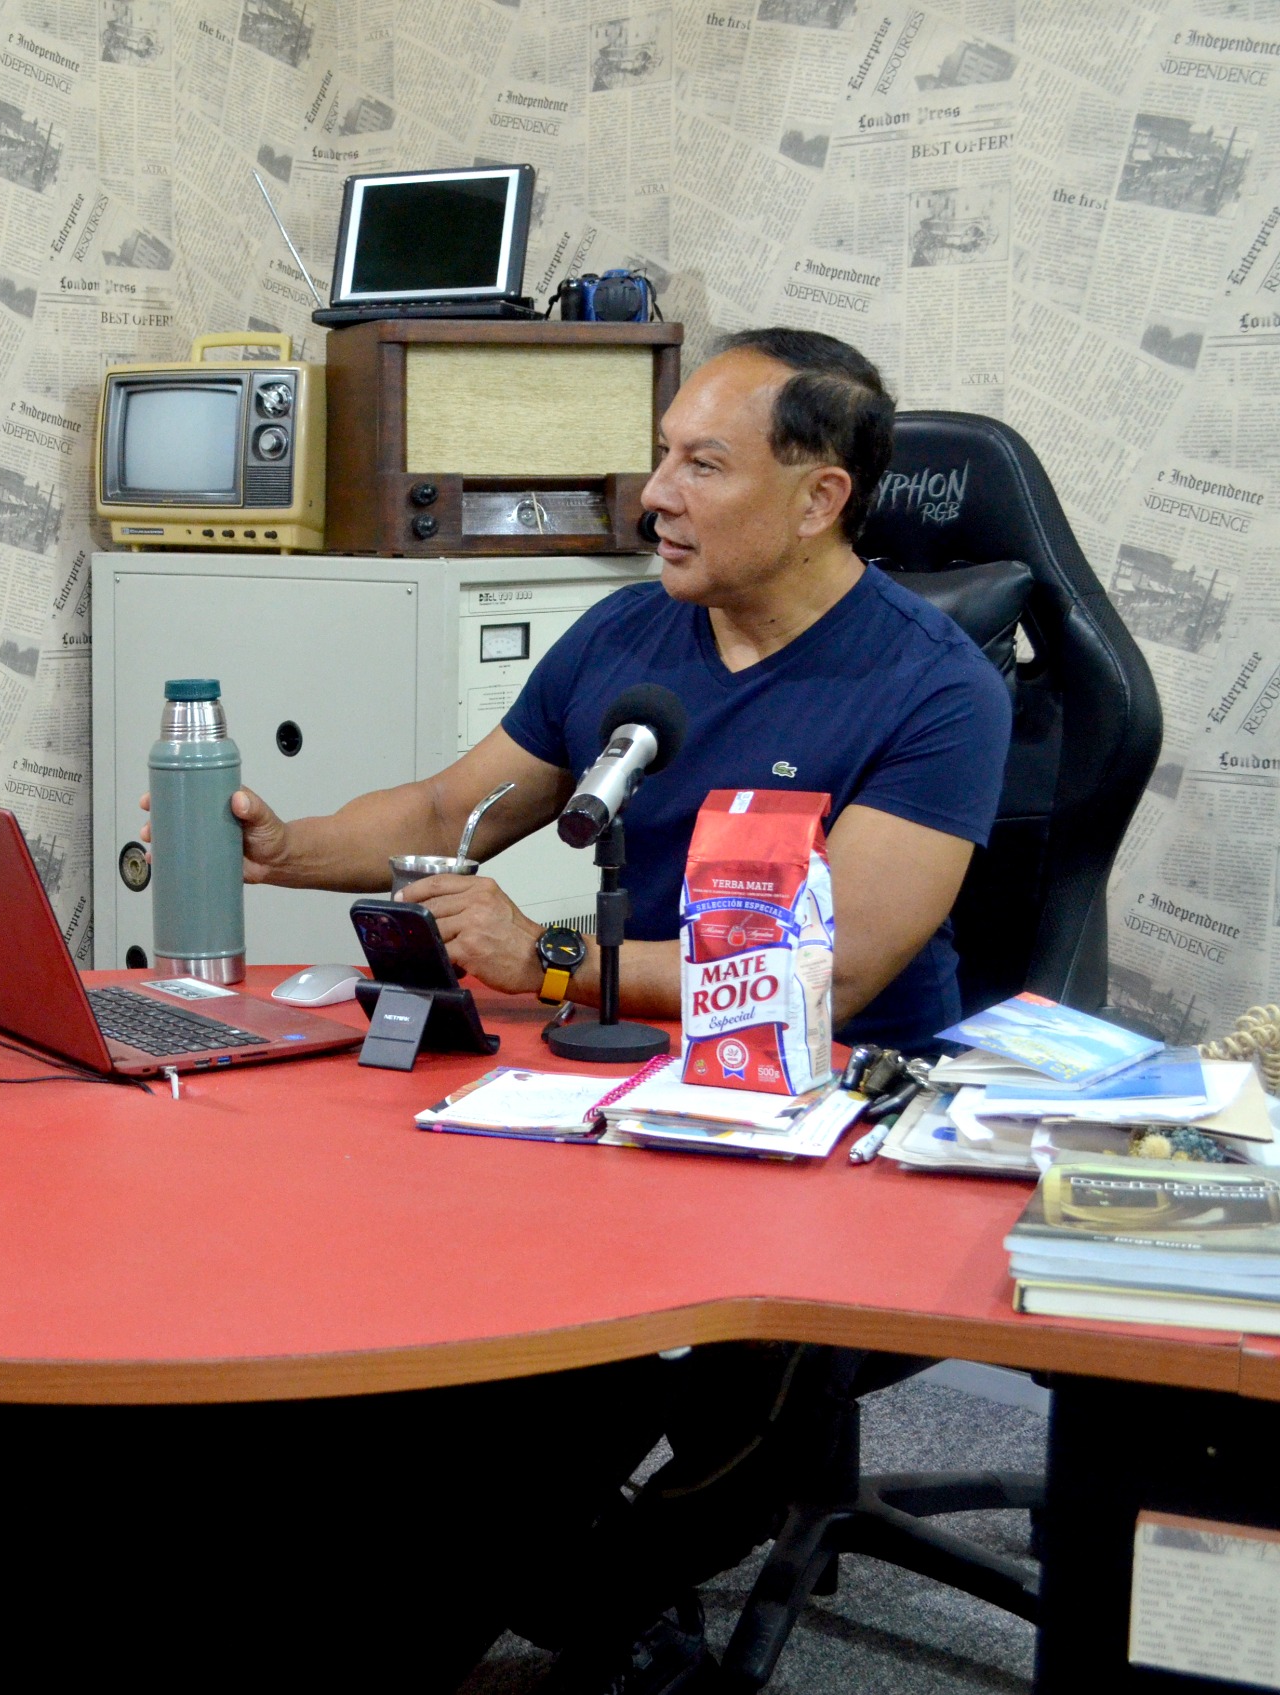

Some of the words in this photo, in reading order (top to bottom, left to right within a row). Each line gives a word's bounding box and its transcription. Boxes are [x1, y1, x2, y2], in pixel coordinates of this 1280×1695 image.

[198, 20, 217, 36] the
[707, 13, 724, 28] the
[877, 11, 926, 96] RESOURCES
[858, 110, 910, 133] London
[910, 141, 951, 159] BEST
[1052, 188, 1075, 205] the
[75, 194, 109, 262] RESOURCES
[59, 277, 101, 294] London
[101, 311, 133, 325] BEST
[877, 459, 969, 510] YPHON
[921, 502, 960, 525] RGB
[712, 879, 744, 889] YERBA
[746, 881, 774, 890] MATE
[696, 899, 742, 911] SELECCIÓN
[744, 901, 783, 918] ESPECIAL
[701, 954, 767, 986] MATE
[692, 975, 778, 1017] ROJO
[709, 1006, 755, 1031] Especial
